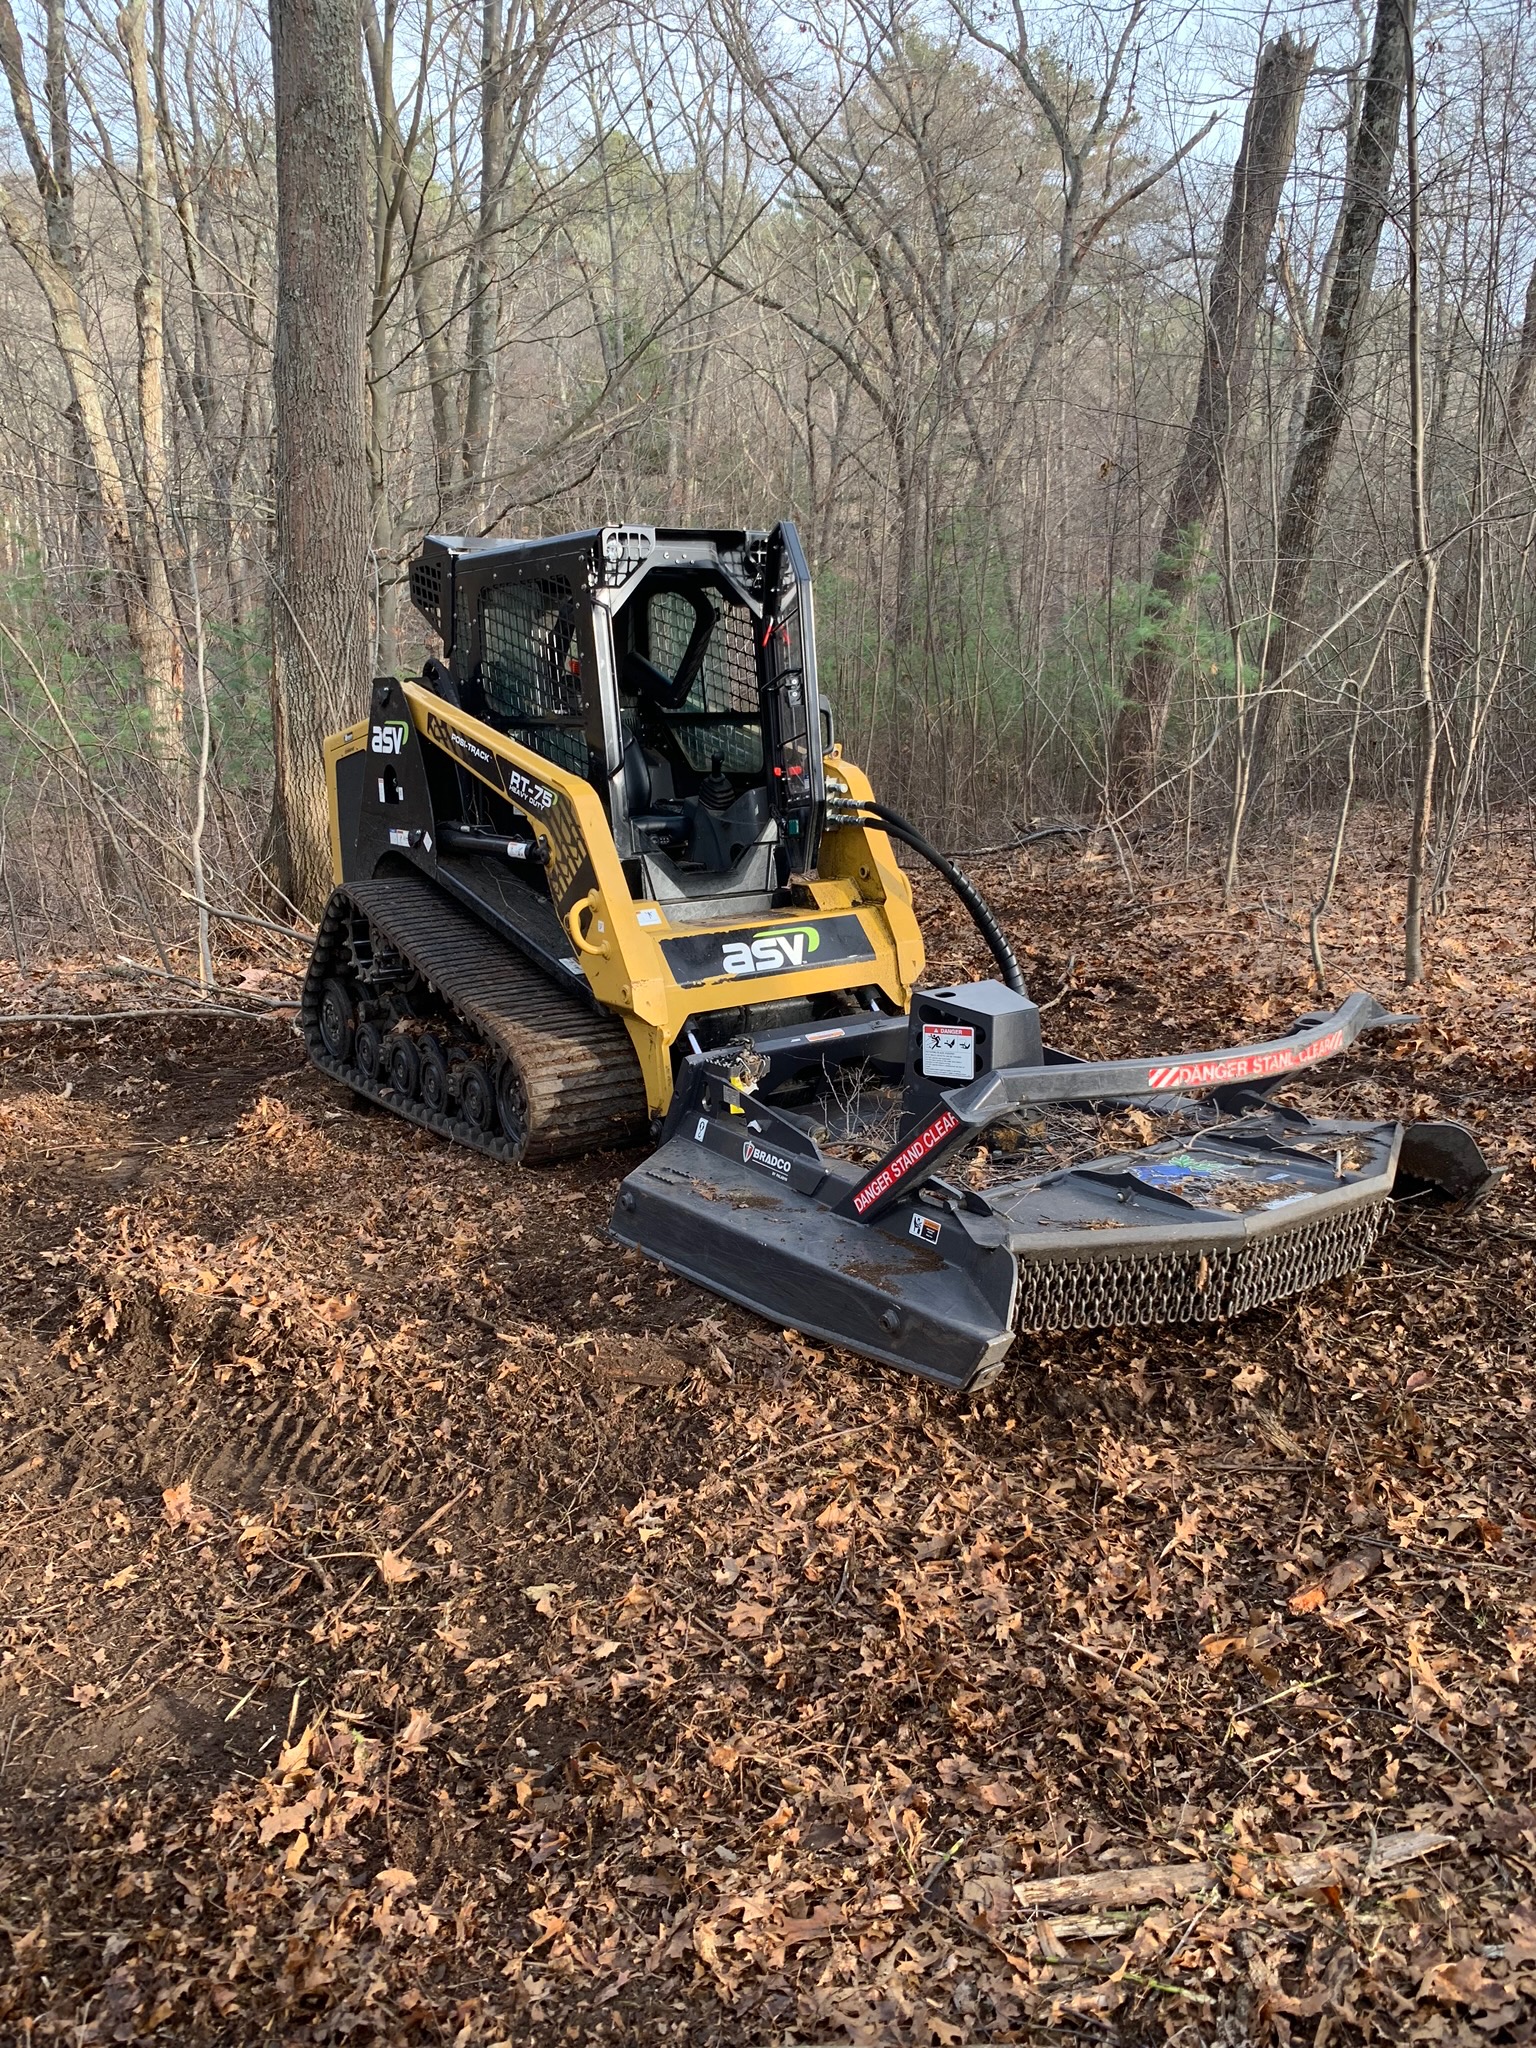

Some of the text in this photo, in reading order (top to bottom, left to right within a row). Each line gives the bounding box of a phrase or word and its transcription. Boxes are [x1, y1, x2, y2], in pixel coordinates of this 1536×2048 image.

[451, 732, 490, 763] POSI-TRACK
[509, 784, 545, 811] HEAVY DUTY
[510, 770, 553, 808] RT-75
[1179, 1059, 1248, 1084] DANGER
[1298, 1036, 1331, 1062] CLEAR
[753, 1148, 792, 1173] BRADCO
[853, 1171, 893, 1214] DANGER
[890, 1141, 924, 1179] STAND
